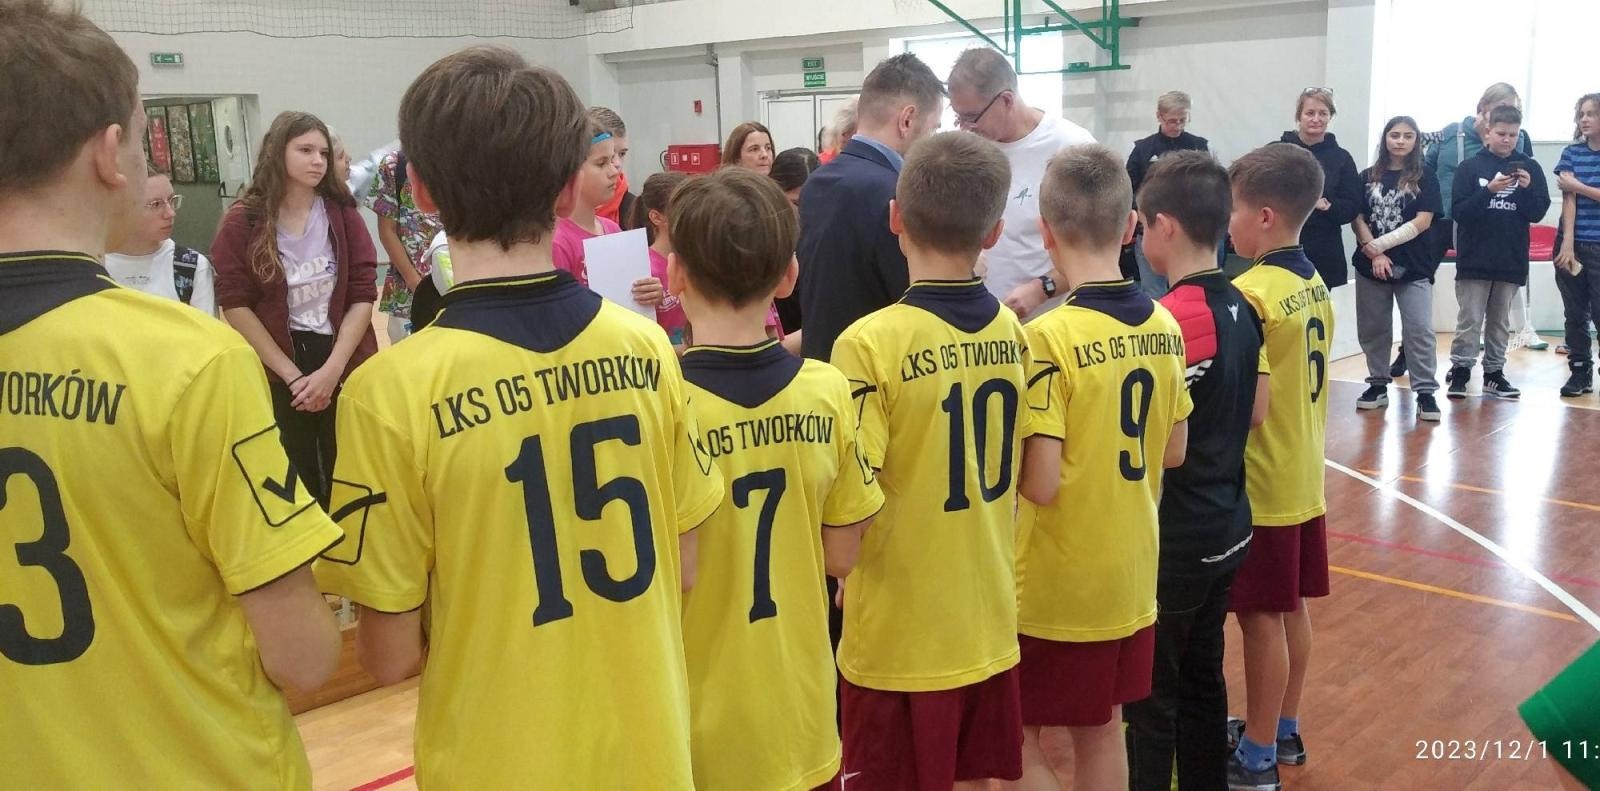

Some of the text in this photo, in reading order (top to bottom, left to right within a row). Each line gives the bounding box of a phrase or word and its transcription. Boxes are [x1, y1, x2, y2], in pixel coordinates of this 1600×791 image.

[1279, 295, 1301, 316] LKS
[901, 339, 1023, 382] LKS 05 TWORK
[1074, 333, 1184, 369] LKS 05 TWORKW
[1306, 317, 1325, 403] 6
[431, 387, 492, 439] LKS
[496, 374, 533, 416] 05
[707, 410, 834, 453] 05 TWORKÓW
[941, 378, 1018, 512] 10
[1119, 368, 1154, 481] 9
[0, 447, 95, 665] 3
[504, 414, 656, 627] 15
[732, 467, 786, 624] 7
